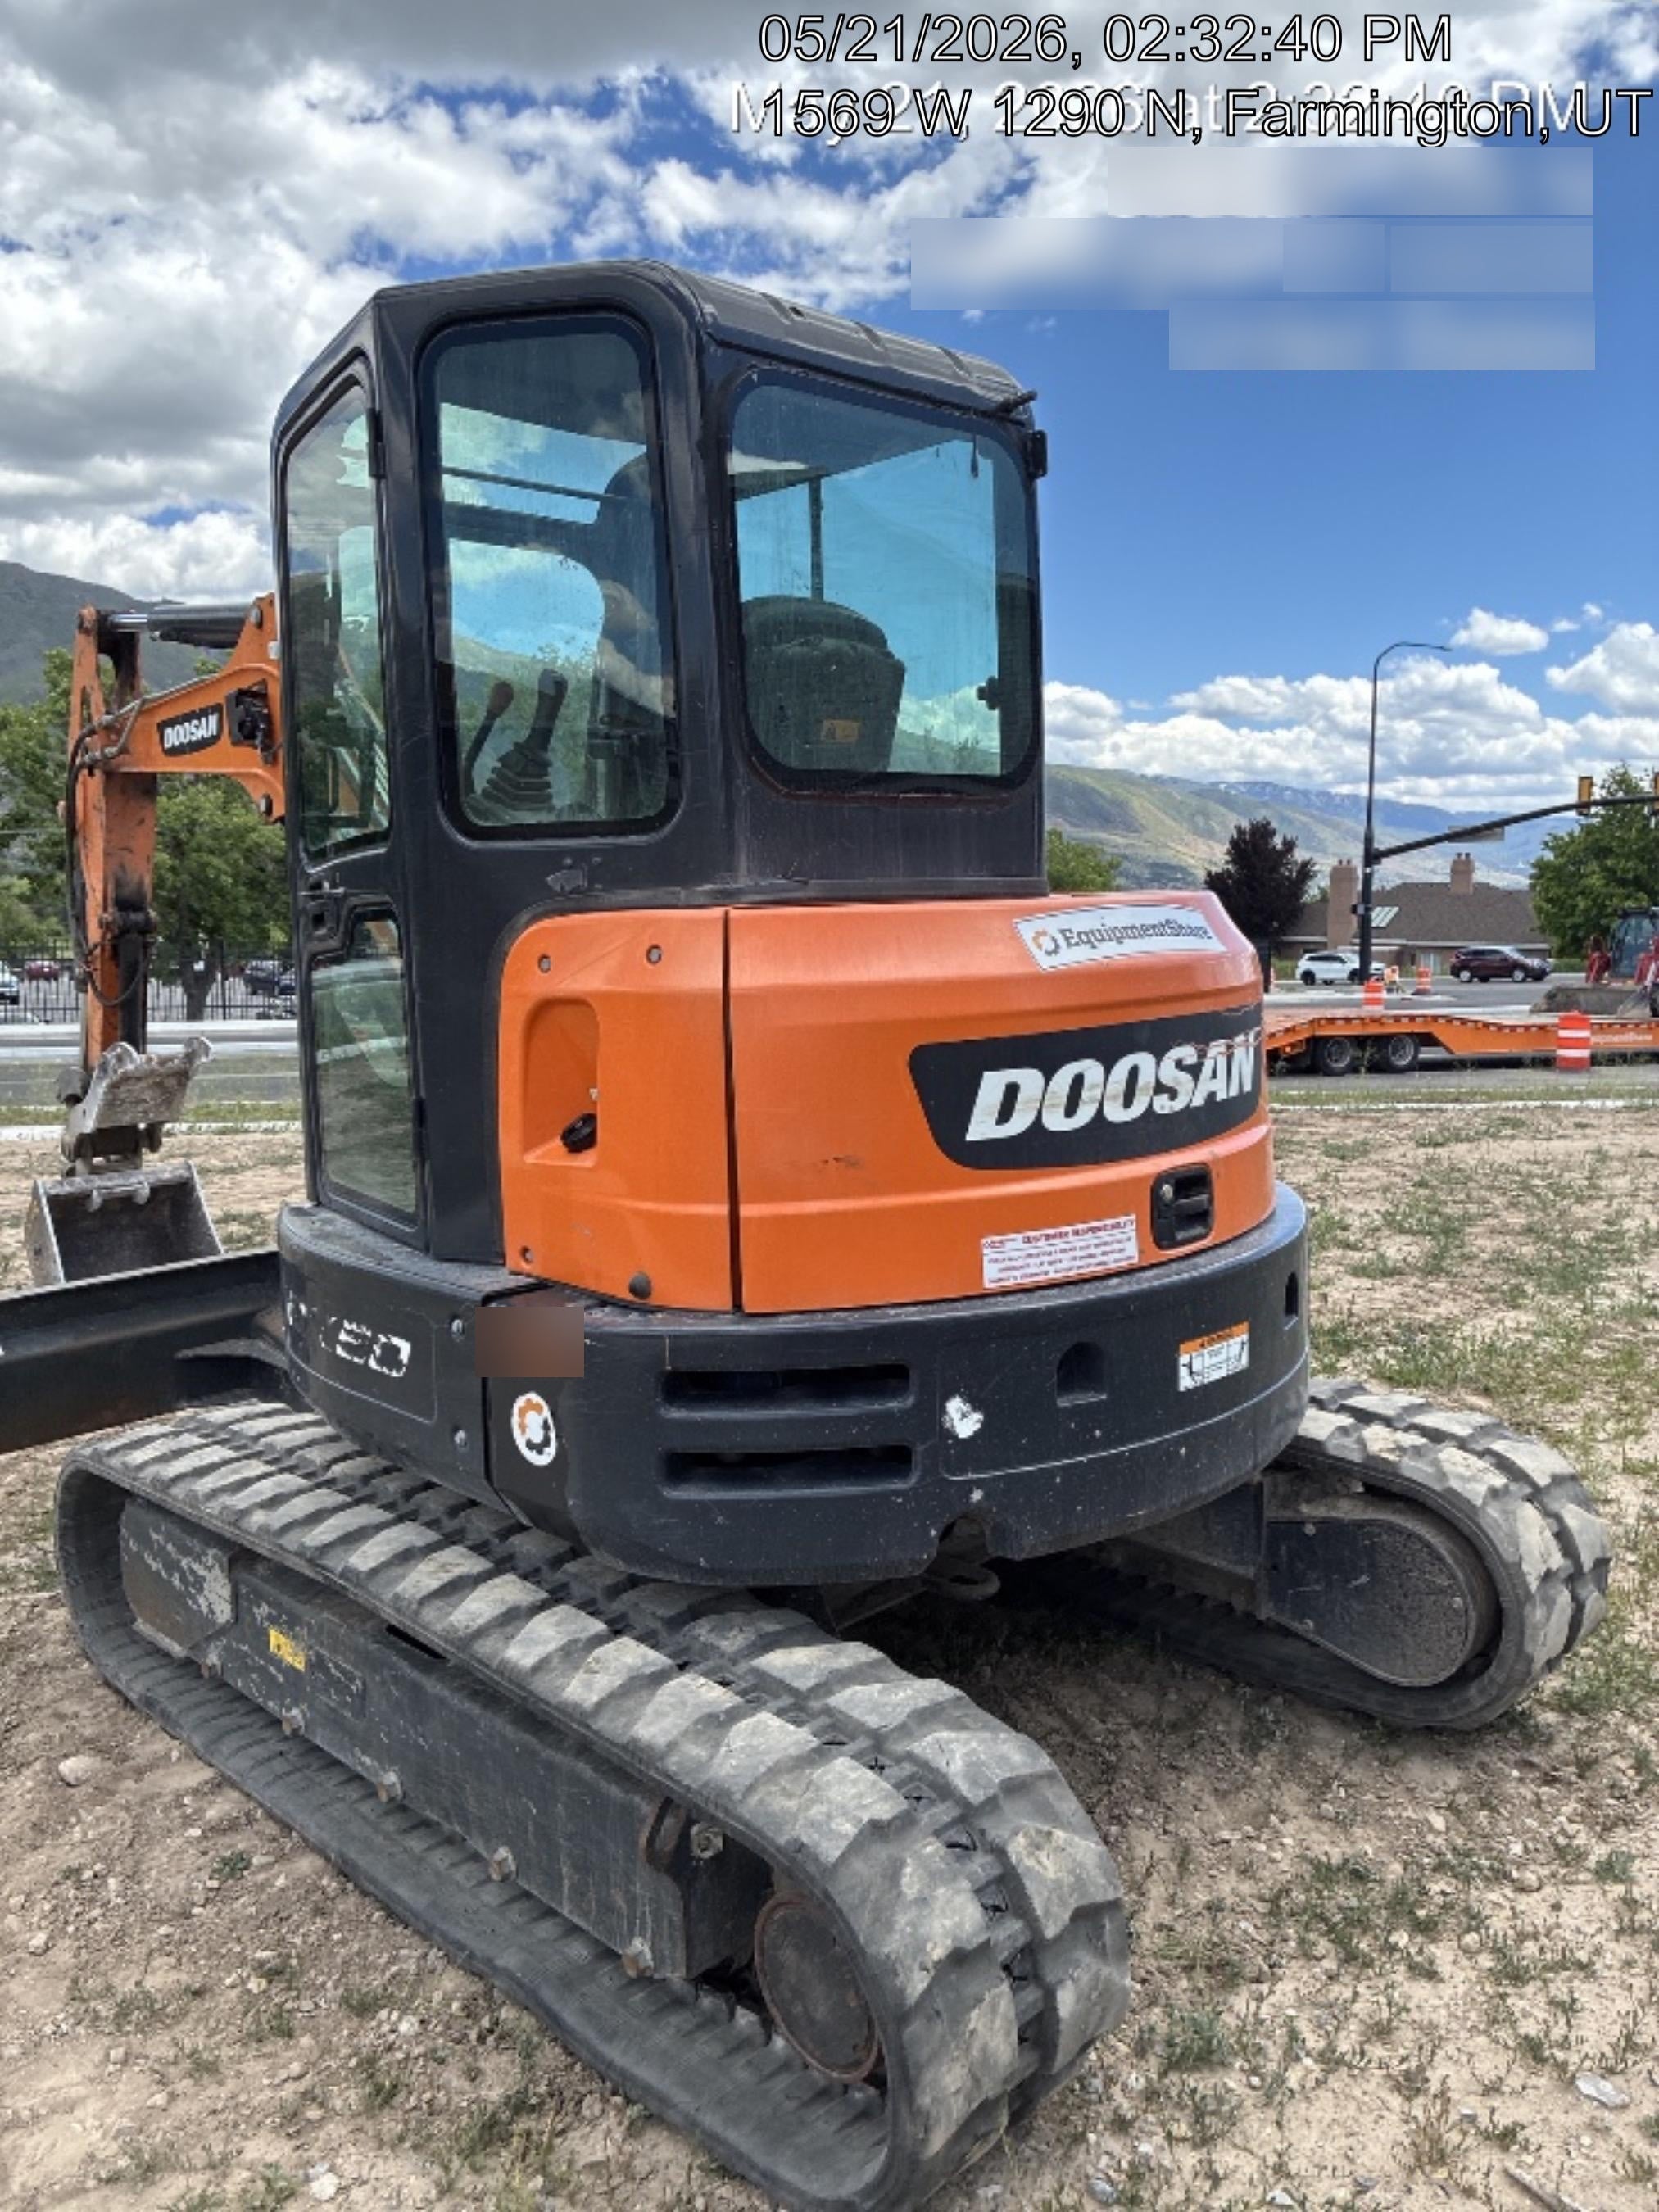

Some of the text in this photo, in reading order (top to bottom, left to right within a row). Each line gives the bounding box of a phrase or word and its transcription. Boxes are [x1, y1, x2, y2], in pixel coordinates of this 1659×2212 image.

[163, 714, 220, 749] DOOSAN
[1058, 918, 1208, 949] EquipmentShare
[965, 1027, 1261, 1142] DOOSAN
